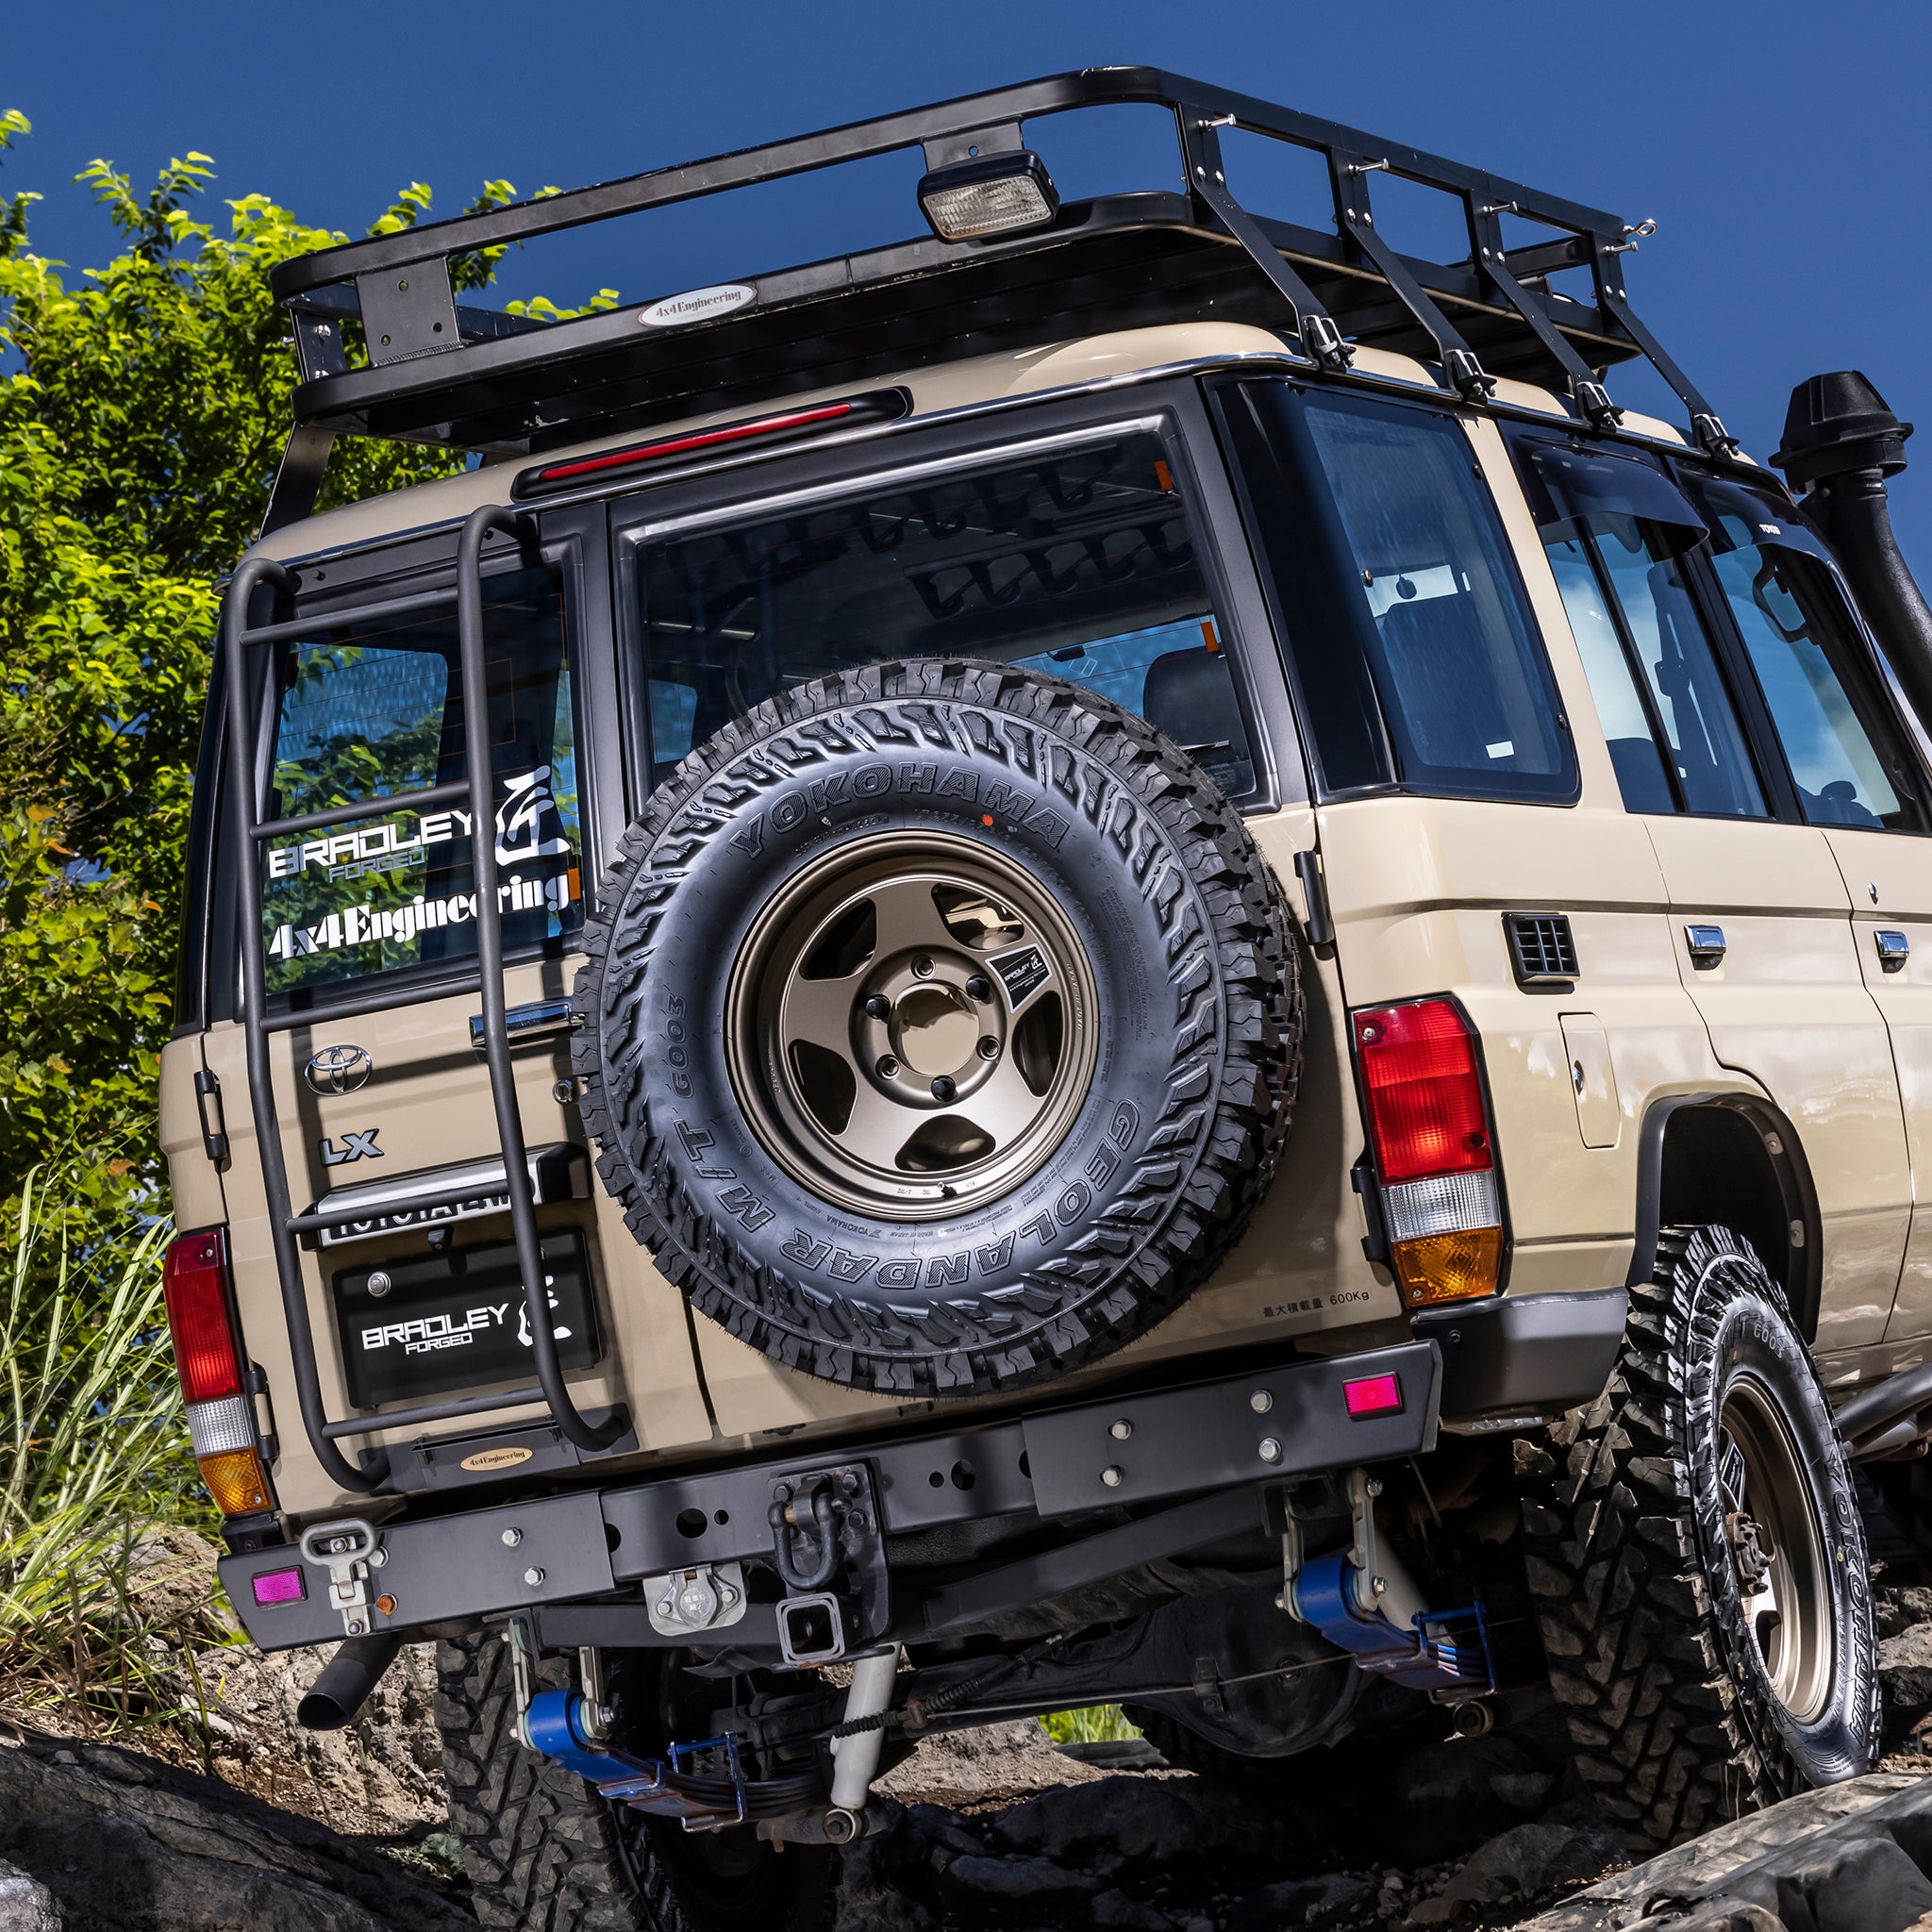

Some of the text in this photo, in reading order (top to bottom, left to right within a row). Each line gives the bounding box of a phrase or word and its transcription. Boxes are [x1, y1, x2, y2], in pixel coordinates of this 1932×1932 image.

[657, 291, 741, 317] 4x4Engineering
[730, 761, 1072, 859] YOKOHAMA
[269, 809, 473, 878] BRADLEY
[329, 847, 425, 883] FORGED
[666, 993, 694, 1098] G003
[318, 1127, 385, 1168] LX
[673, 1118, 776, 1233] M/T
[779, 1098, 1141, 1289] GEOLANDAR
[361, 1303, 509, 1350] BRADLEY
[1263, 1291, 1370, 1318] 最大積載量 600Kg
[405, 1332, 474, 1355] FORGED
